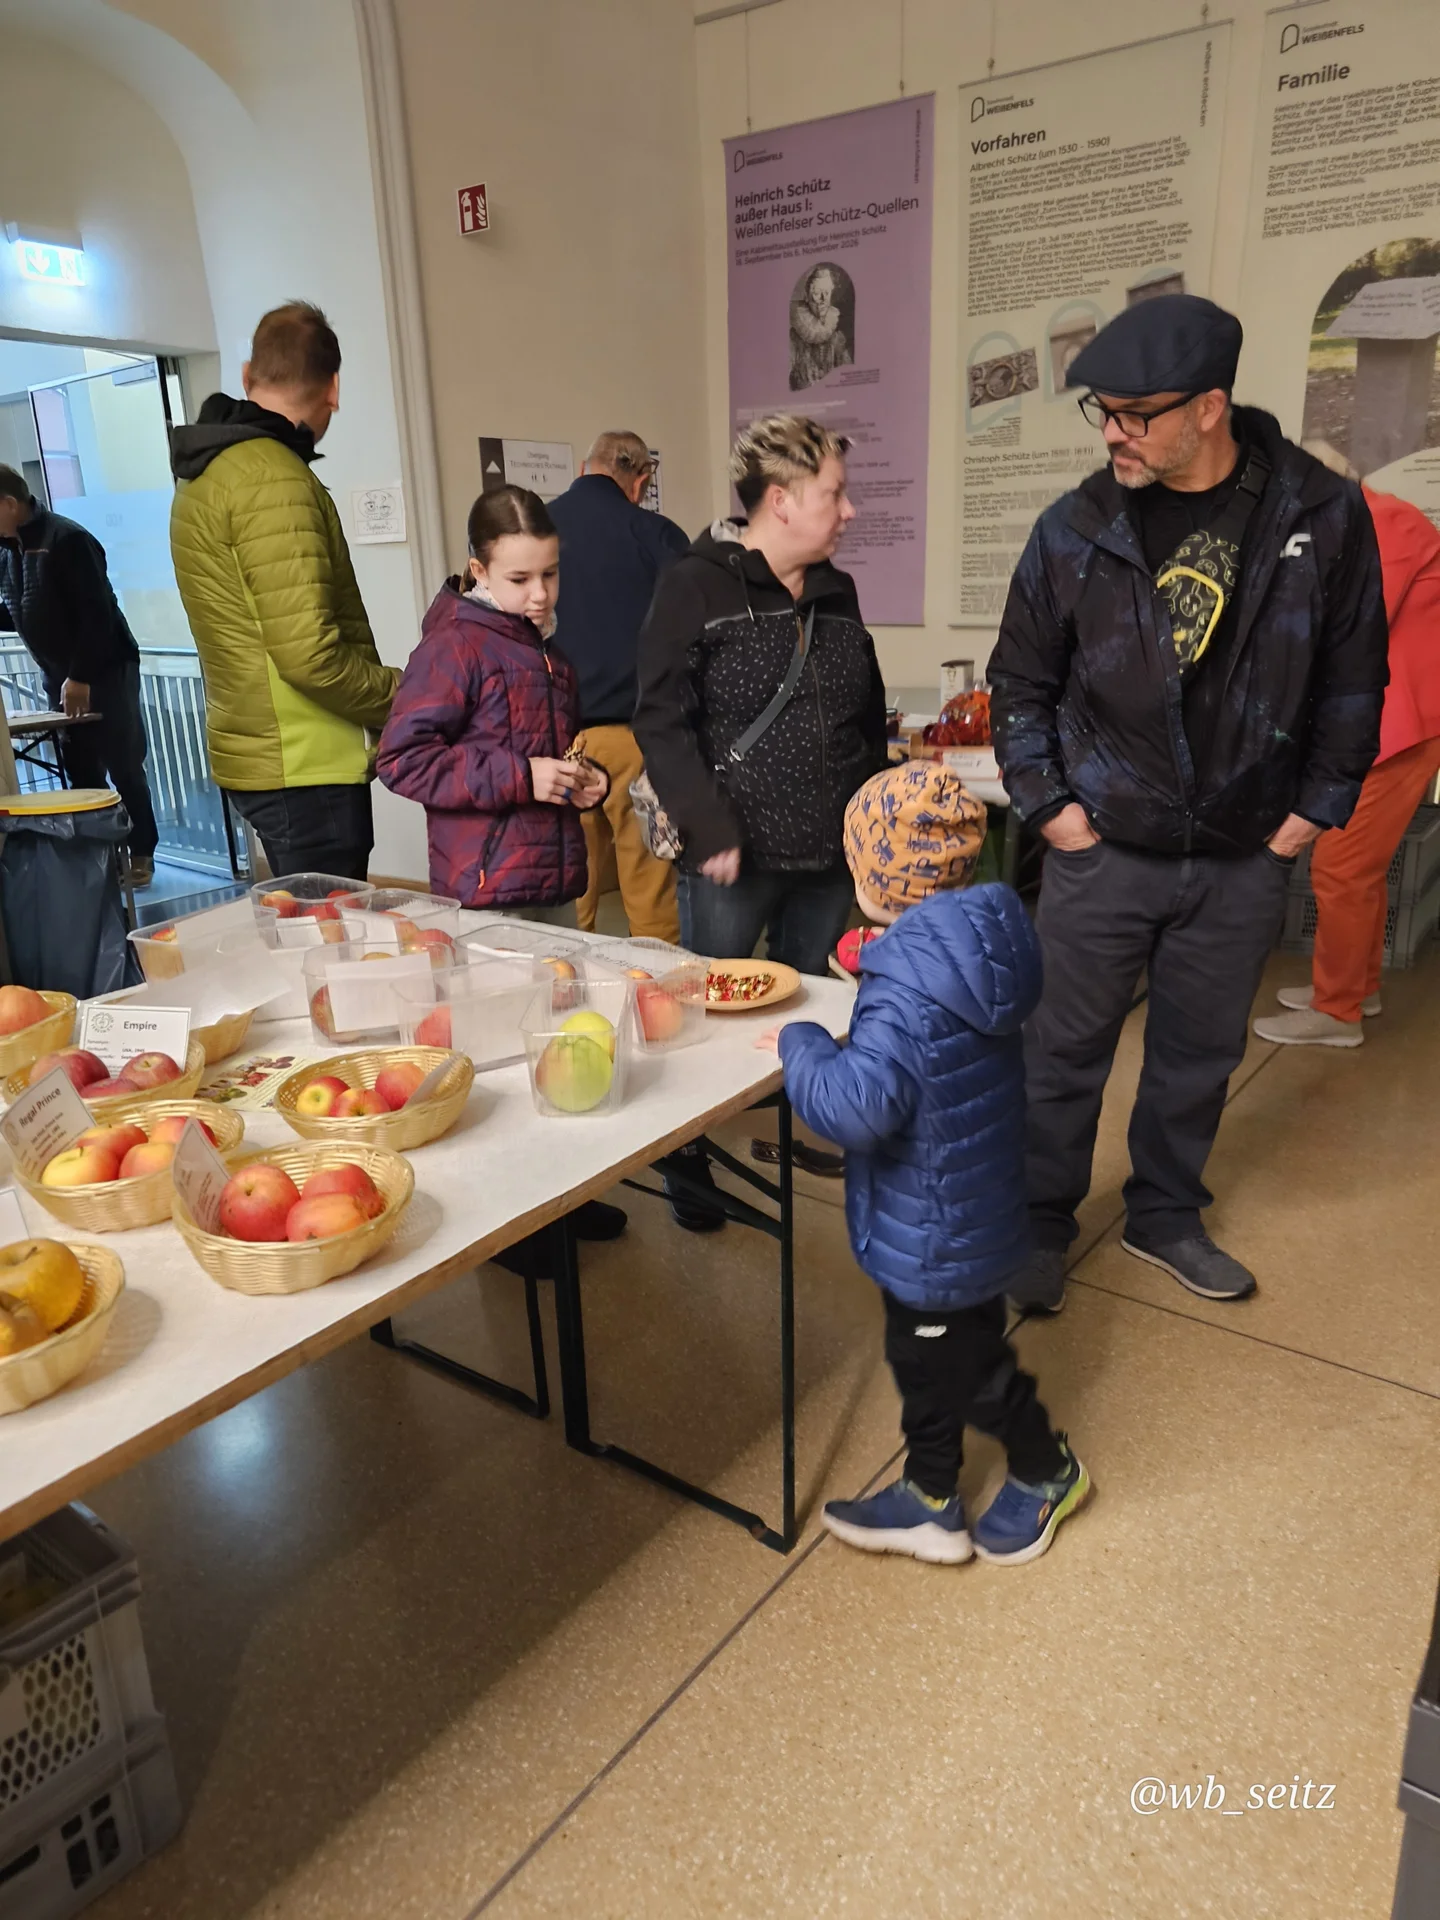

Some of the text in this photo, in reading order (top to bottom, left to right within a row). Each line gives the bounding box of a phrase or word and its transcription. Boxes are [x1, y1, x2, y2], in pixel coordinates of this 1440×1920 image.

[1277, 64, 1350, 92] Familie
[969, 158, 1004, 172] Albrecht
[1007, 151, 1036, 165] Schütz
[1038, 147, 1056, 160] (um
[1058, 142, 1077, 154] 1530
[1087, 136, 1110, 148] 1590)
[970, 128, 1046, 155] Vorfahren
[735, 178, 831, 208] Heinrich Schütz
[735, 207, 768, 224] außer
[770, 200, 802, 216] Haus
[735, 197, 919, 240] Weißenfelser Schütz-Quellen
[829, 228, 861, 242] Heinrich
[862, 224, 887, 237] Schütz
[744, 250, 783, 266] September
[784, 248, 794, 259] bis
[802, 241, 840, 256] November
[963, 454, 999, 464] Christoph
[1002, 452, 1030, 461] Schütz
[124, 1020, 158, 1032] Empire
[19, 1088, 62, 1128] Regal Prince
